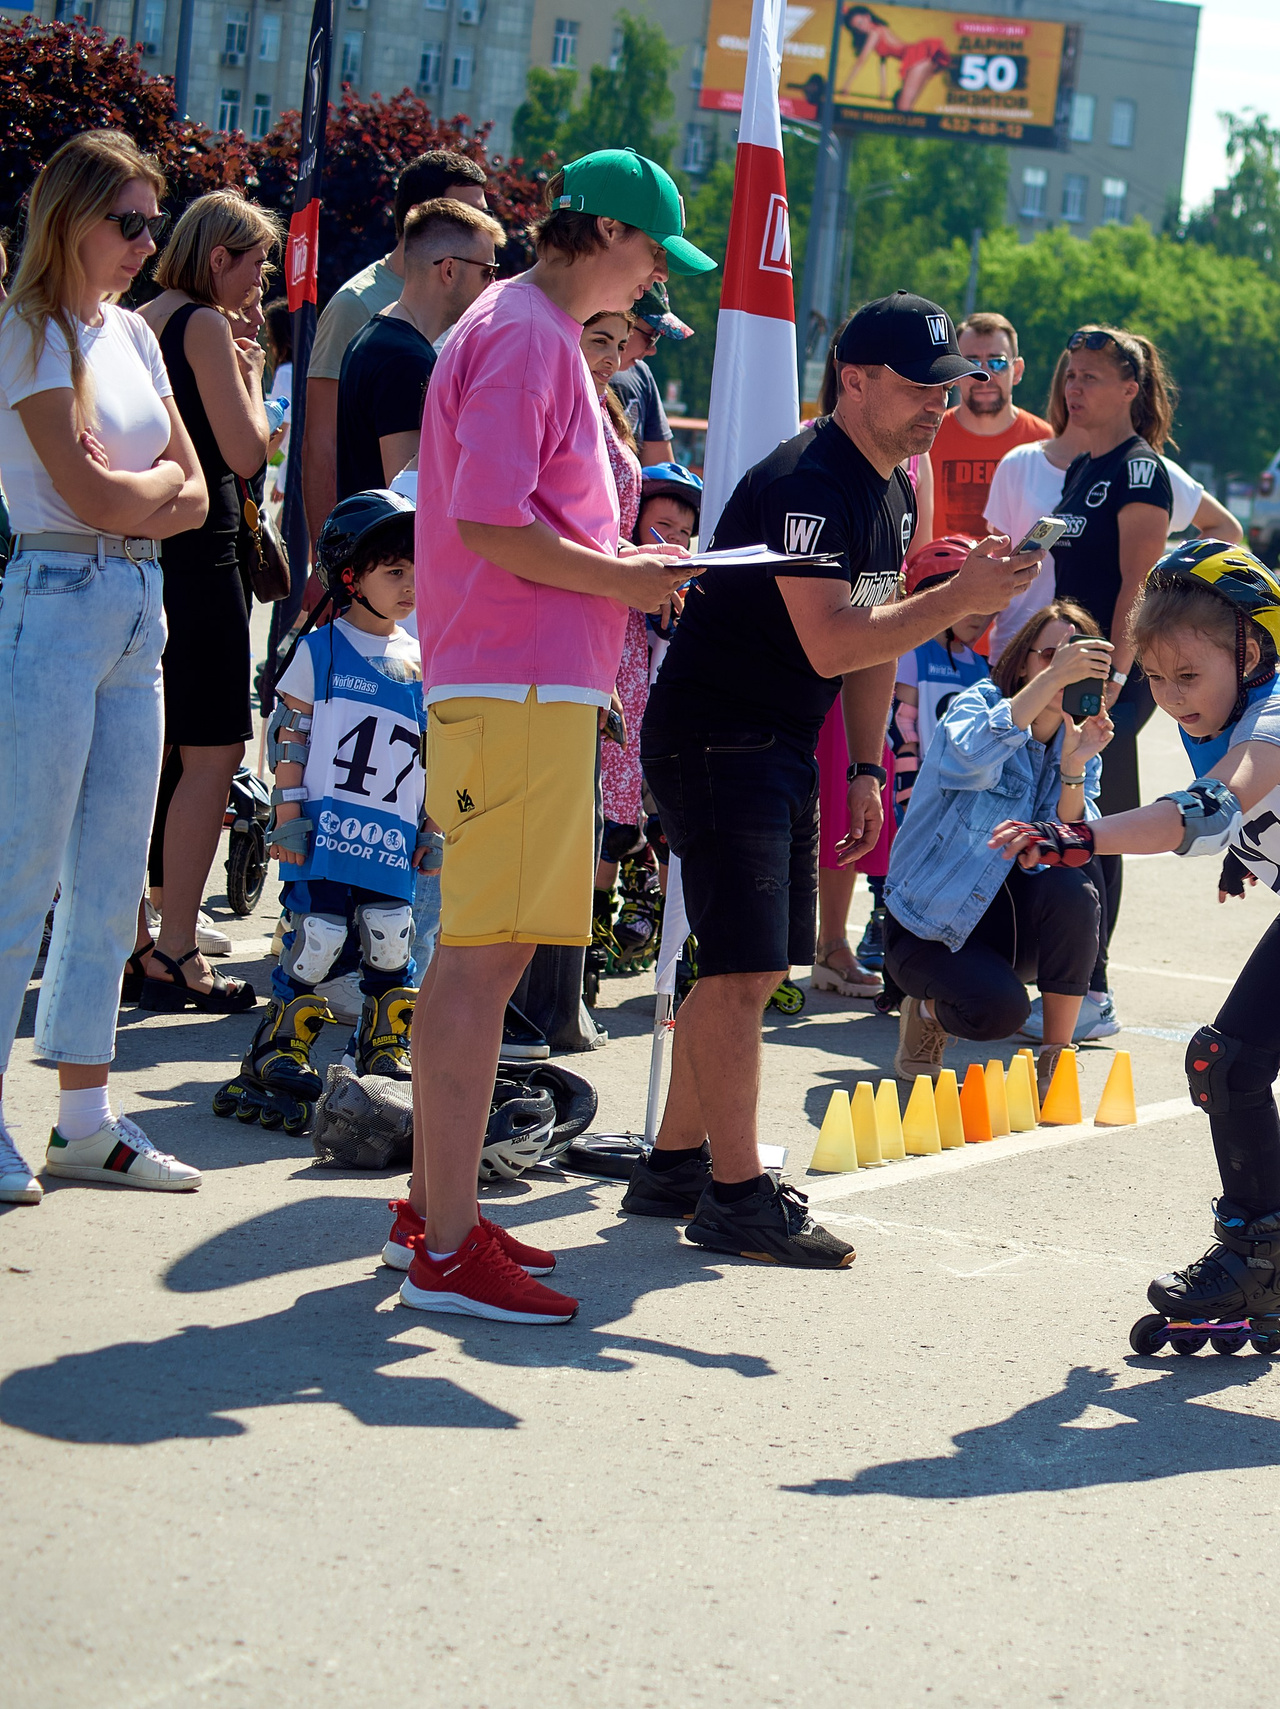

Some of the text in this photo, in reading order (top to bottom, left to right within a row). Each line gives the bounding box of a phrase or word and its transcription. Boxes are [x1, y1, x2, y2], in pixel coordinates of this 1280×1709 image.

[958, 54, 1019, 93] 50
[929, 317, 947, 342] W
[1132, 460, 1153, 485] W
[788, 518, 818, 553] W
[354, 679, 377, 694] Class
[332, 715, 422, 804] 47
